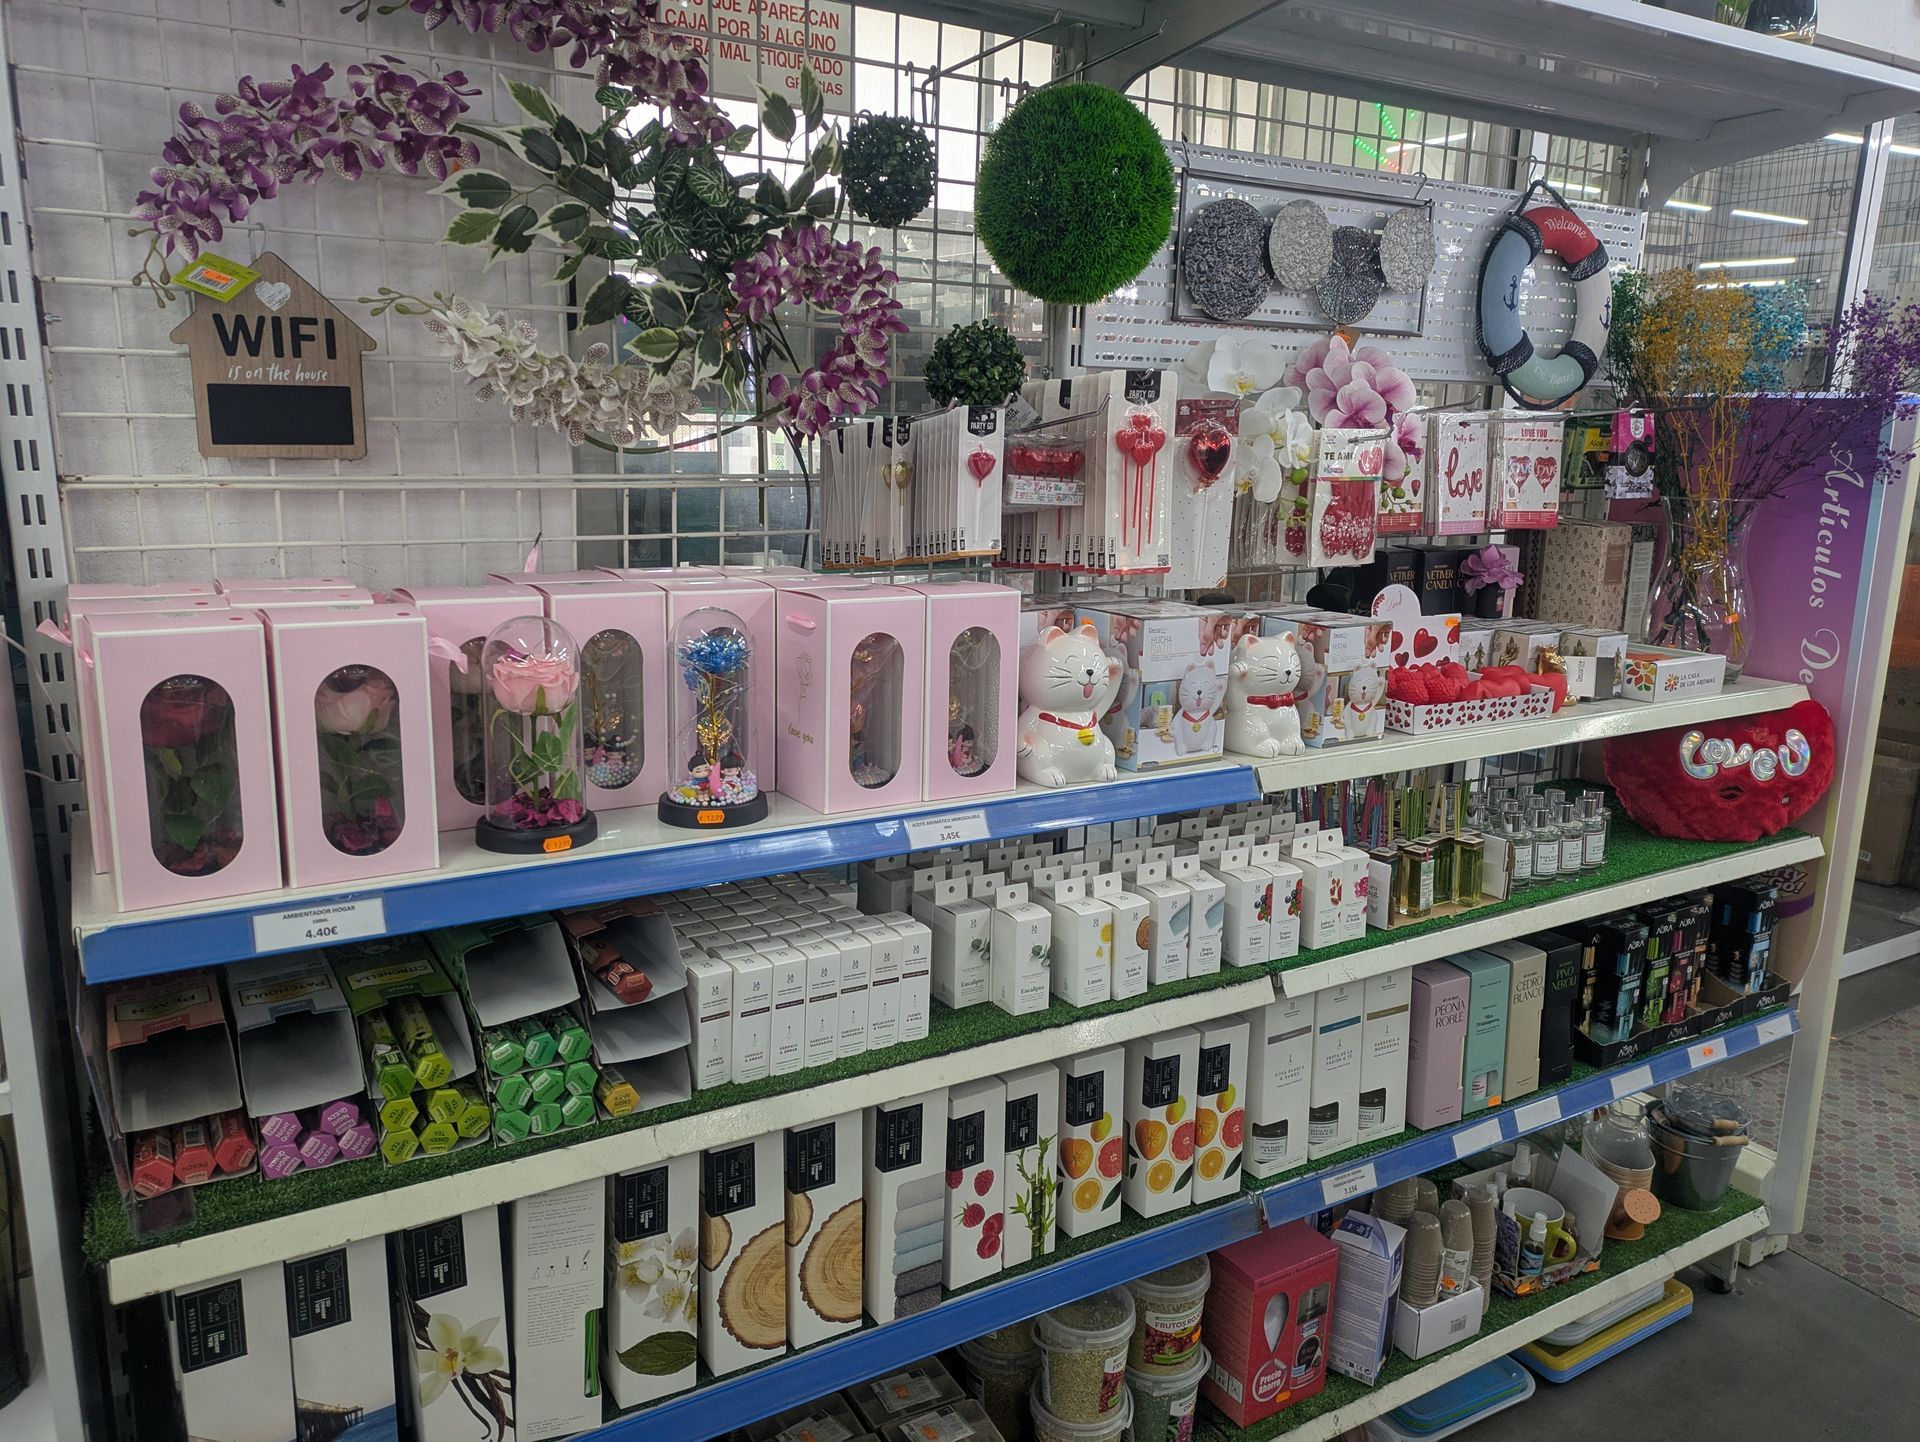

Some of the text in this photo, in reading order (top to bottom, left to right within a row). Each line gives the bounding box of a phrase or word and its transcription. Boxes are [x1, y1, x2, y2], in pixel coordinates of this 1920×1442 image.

[749, 0, 840, 30] APAREZCAN
[664, 9, 836, 52] CAJA POR SI ALGUNO
[719, 41, 751, 62] MAL
[1544, 216, 1586, 239] Welcome
[212, 313, 337, 360] WIFI
[228, 362, 328, 382] is on the house
[1129, 389, 1156, 399] PARTY GO
[970, 421, 994, 430] PARTY GO
[1521, 428, 1548, 438] LOVE YOU
[1325, 452, 1335, 460] TE
[1445, 447, 1483, 500] love
[940, 831, 961, 841] 3.45€
[282, 905, 356, 920] AMBIENTADOR HOGAR
[305, 926, 339, 939] 4.40€
[353, 964, 429, 985] CITRONELLA
[1516, 975, 1544, 992] CEDRO
[1512, 986, 1545, 1005] BLANCO
[1435, 1012, 1464, 1028] ROBLE
[327, 1106, 347, 1121] QUEEN
[331, 1112, 350, 1127] NIGHT
[275, 1121, 291, 1138] NIGHT
[280, 1124, 297, 1142] QUEEN
[312, 1143, 328, 1160] NIGHT
[351, 1135, 366, 1152] NIGHT
[356, 1137, 372, 1155] QUEEN
[268, 1150, 285, 1169] QUEEN
[275, 1153, 291, 1171] NIGHT
[318, 1146, 335, 1164] QUEEN
[1155, 1321, 1187, 1329] FRUTOS
